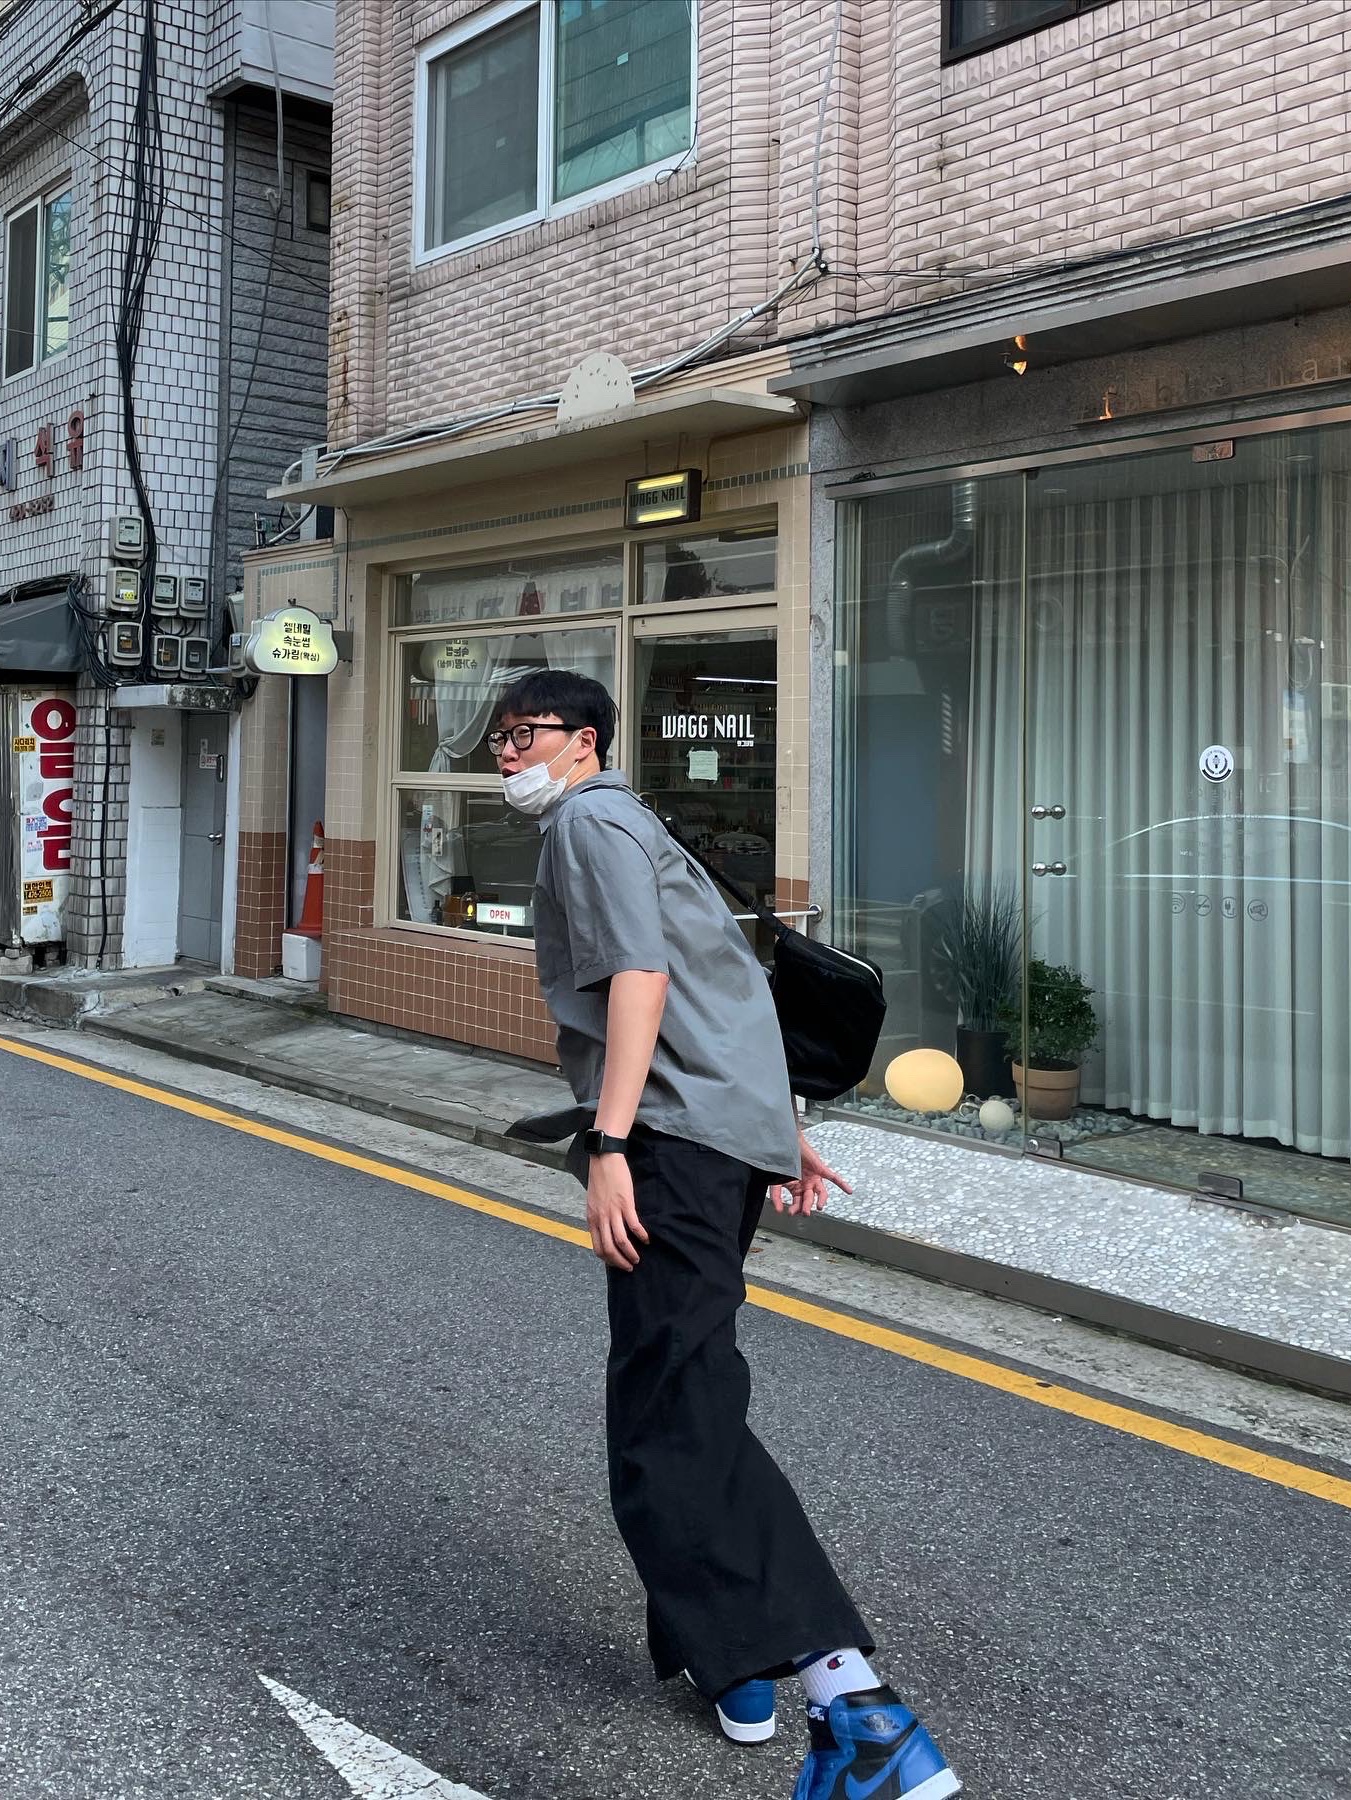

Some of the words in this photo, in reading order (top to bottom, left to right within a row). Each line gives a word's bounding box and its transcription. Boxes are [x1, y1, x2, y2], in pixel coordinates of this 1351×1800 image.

[35, 409, 84, 477] 석유
[630, 491, 658, 507] WAGG
[661, 486, 686, 503] NAIL
[283, 622, 311, 635] 젤네일
[283, 635, 311, 648] 속눈썹
[272, 648, 320, 662] 슈가링(왁싱)
[662, 714, 708, 738] WAGG
[714, 714, 755, 738] NAIL
[489, 909, 511, 920] OPEN
